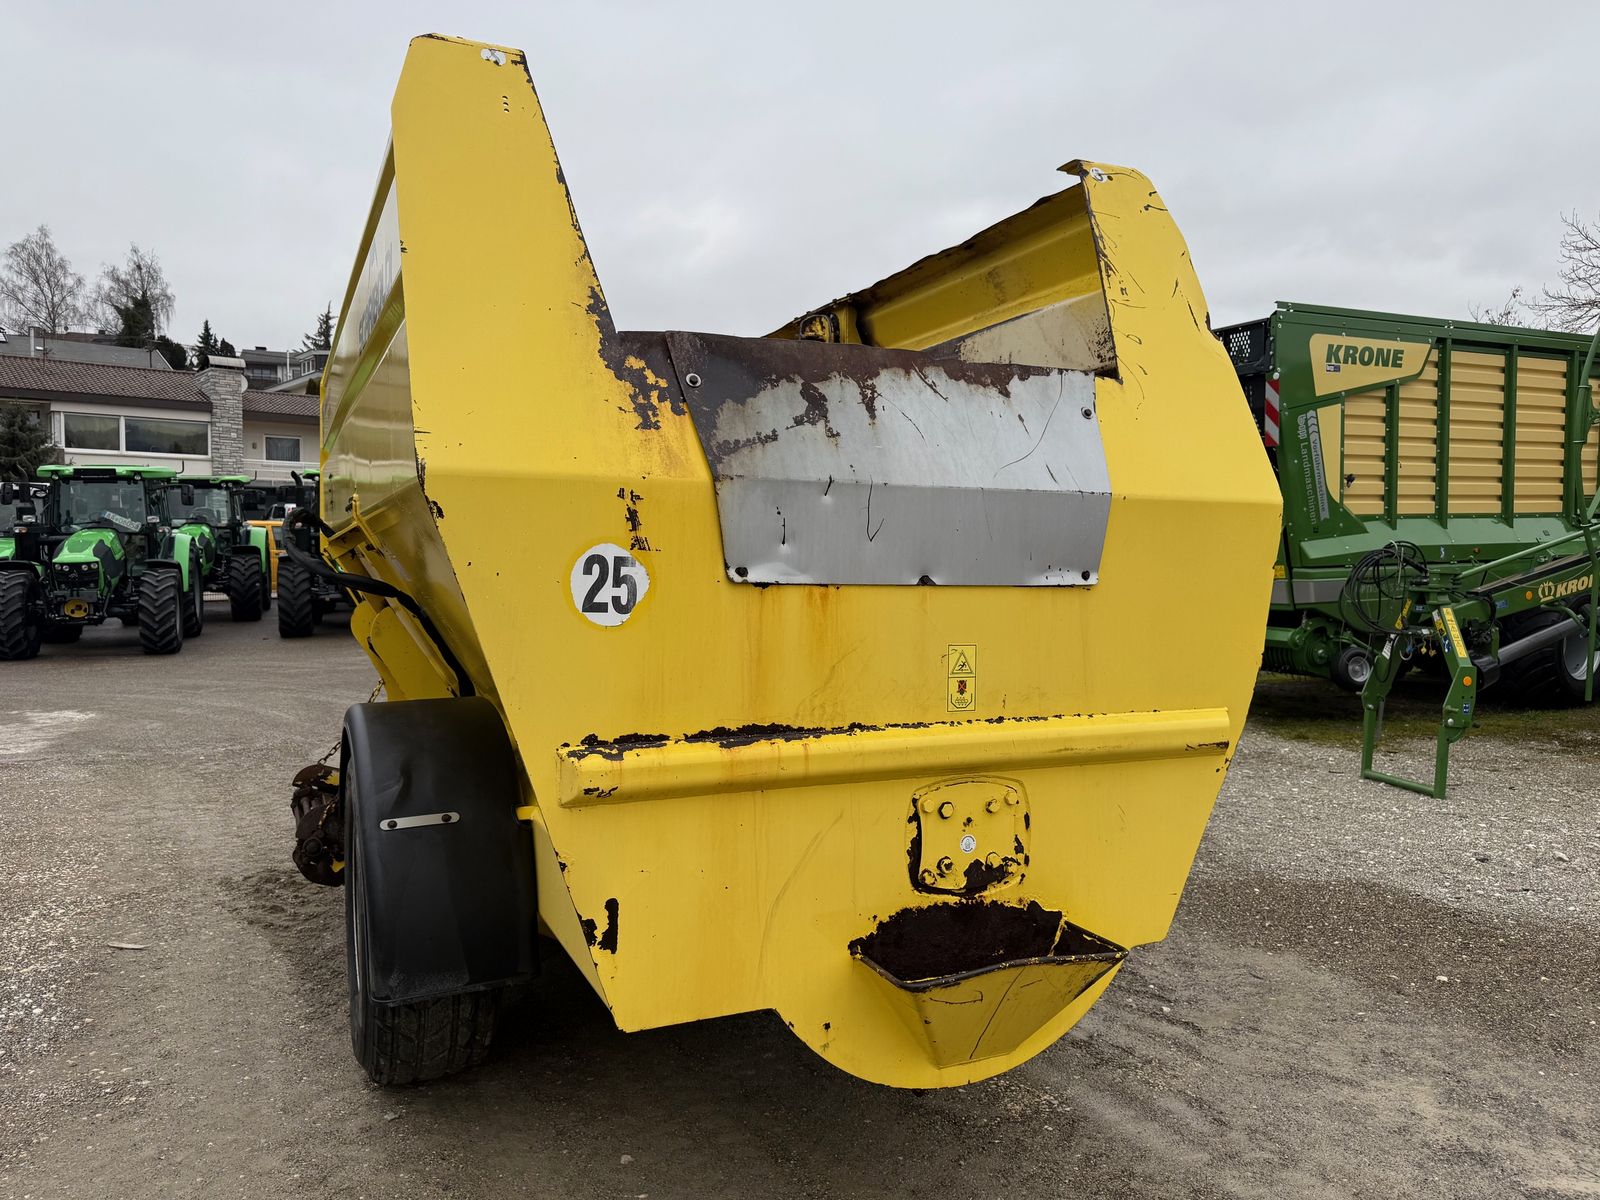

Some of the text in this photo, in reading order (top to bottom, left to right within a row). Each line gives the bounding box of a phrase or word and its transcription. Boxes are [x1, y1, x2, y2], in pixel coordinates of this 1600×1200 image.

[1325, 344, 1404, 368] KRONE
[1300, 441, 1317, 525] Landmaschinen
[1312, 438, 1326, 513] Vorführmaschine
[582, 554, 637, 614] 25
